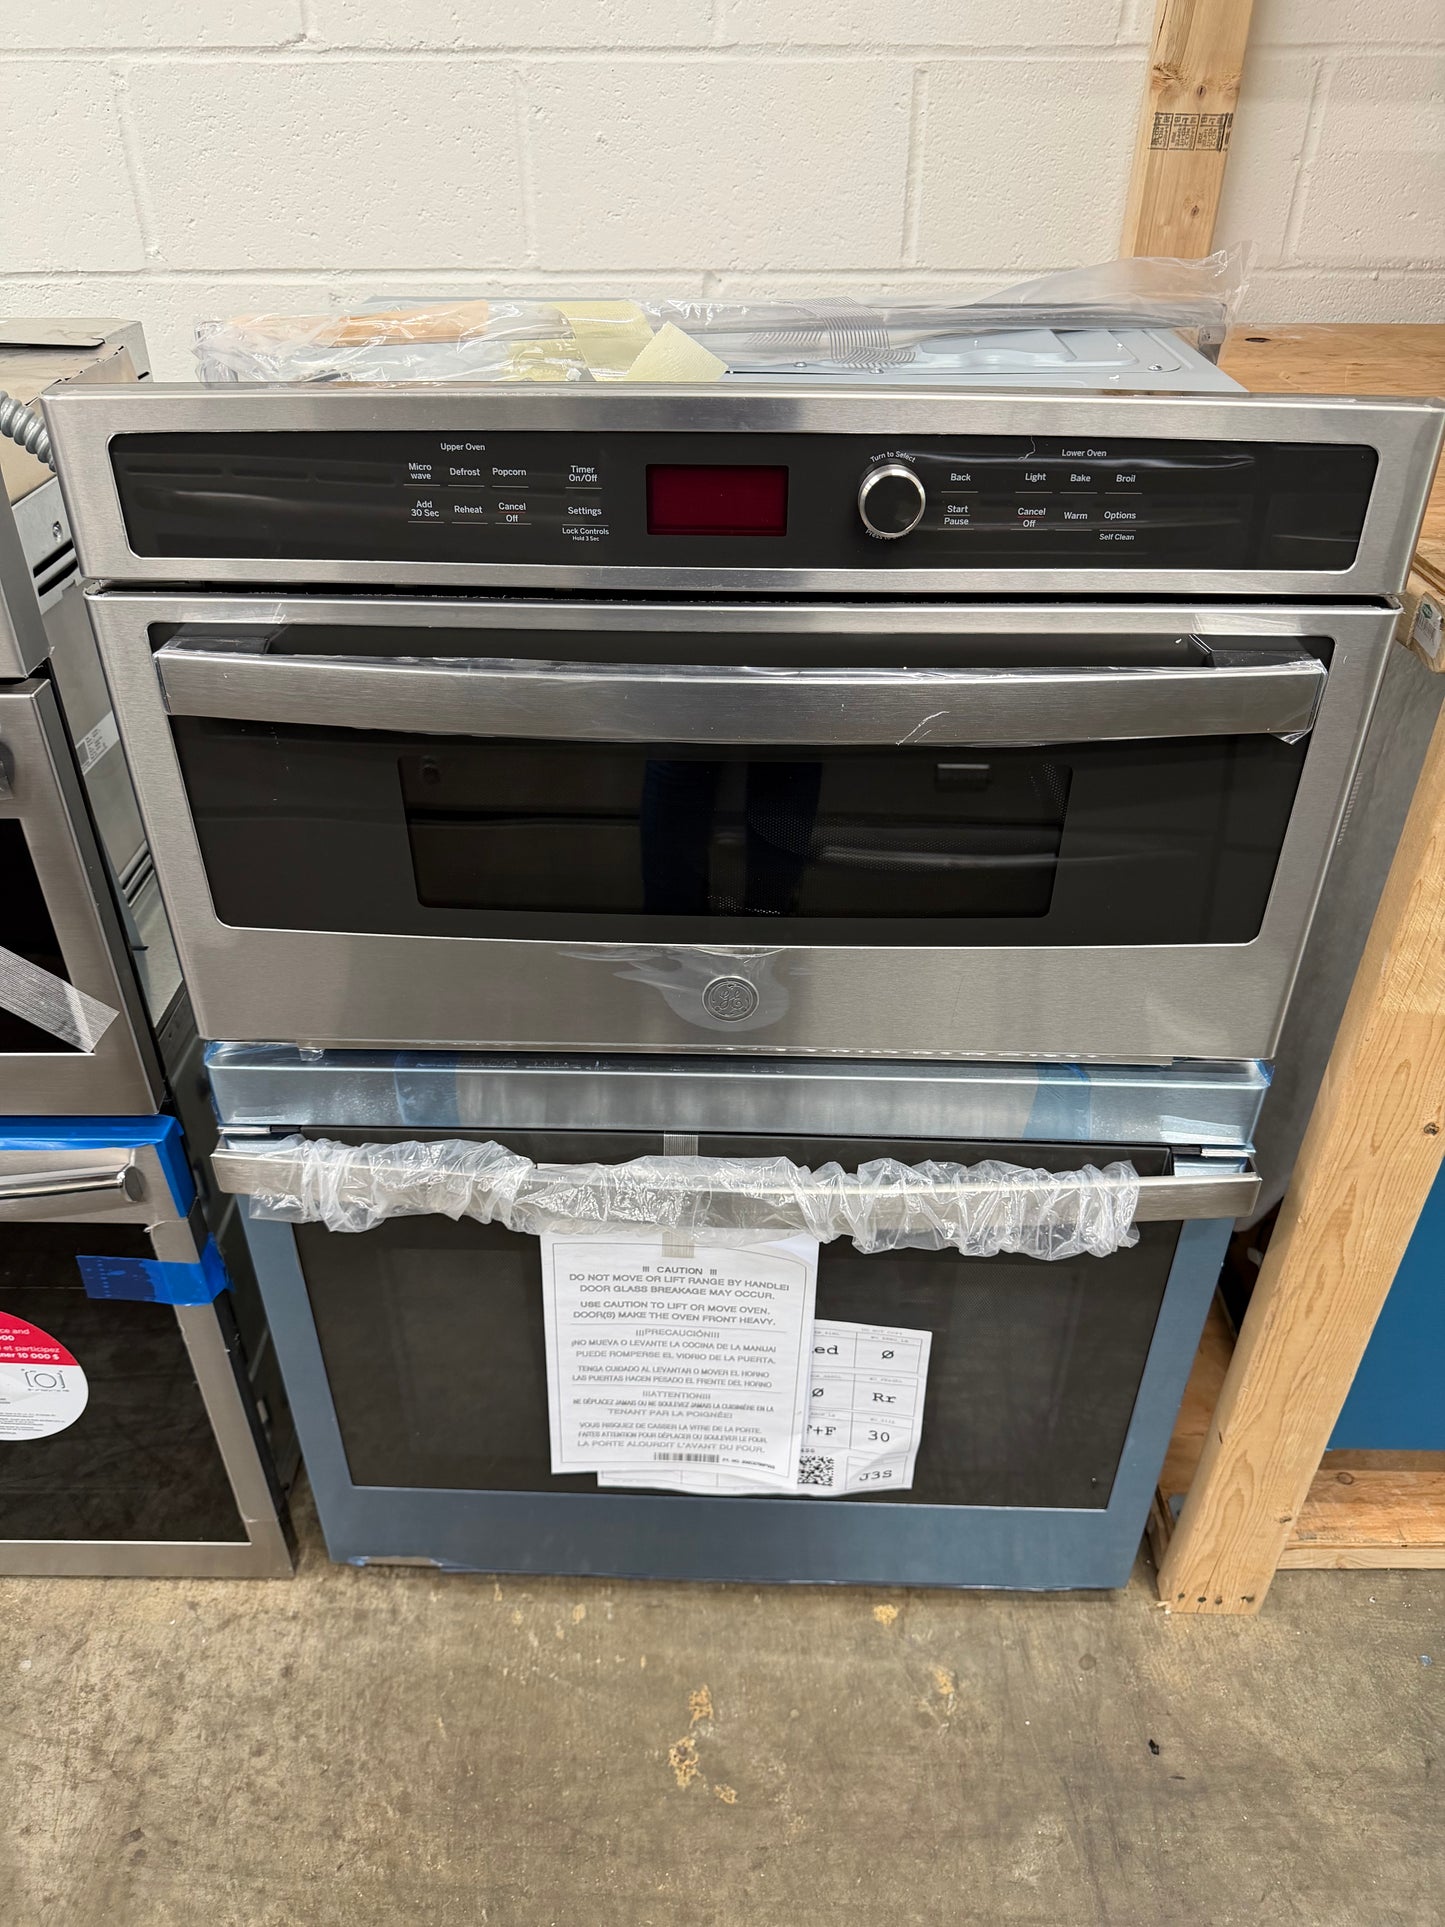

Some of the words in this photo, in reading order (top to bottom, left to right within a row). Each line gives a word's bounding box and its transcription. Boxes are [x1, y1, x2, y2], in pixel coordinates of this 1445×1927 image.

[440, 442, 464, 452] Upper
[465, 442, 486, 451] Oven
[869, 453, 886, 463] Turn
[895, 450, 916, 463] Select
[1061, 449, 1085, 457] Lower
[1086, 449, 1107, 457] Oven
[408, 462, 432, 471] Micro
[570, 465, 595, 474] Timer
[449, 467, 480, 476] Defrost
[492, 467, 527, 477] Popcorn
[568, 473, 598, 482] On/Off
[950, 473, 971, 482] Back
[1025, 472, 1047, 483] Light
[1070, 473, 1091, 482] Bake
[1116, 474, 1136, 483] Broil
[416, 500, 433, 508] Add
[498, 502, 527, 511] Cancel
[411, 508, 423, 517] 30
[424, 509, 440, 517] Sec
[454, 505, 483, 514] Reheat
[567, 506, 602, 516] Settings
[947, 505, 969, 513] Start
[1017, 507, 1046, 516] Cancel
[505, 514, 518, 522] Off
[1063, 511, 1088, 520] Warm
[1103, 510, 1137, 520] Options
[943, 517, 969, 525] Pause
[1022, 519, 1036, 528] Off
[562, 527, 579, 535] Lock
[580, 527, 610, 535] Controls
[1099, 533, 1114, 541] Self
[656, 1266, 703, 1275] CAUTION
[569, 1273, 585, 1281] DO
[612, 1274, 643, 1282] MOVE
[645, 1275, 661, 1283] OR
[688, 1276, 725, 1286] RANGE
[727, 1279, 742, 1287] BY
[613, 1285, 648, 1293] GLASS
[651, 1286, 706, 1296] BREAKAGE
[709, 1289, 732, 1297] MAY
[734, 1290, 775, 1300] OCCUR.
[667, 1302, 687, 1310] LIFT
[690, 1303, 705, 1311] OR
[707, 1305, 737, 1313] MOVE
[740, 1306, 770, 1315] OVEN.
[573, 1311, 616, 1320] DOOR(S)
[648, 1312, 669, 1320] THE
[671, 1313, 699, 1321] OVEN
[702, 1315, 737, 1323] FRONT
[740, 1316, 776, 1326] HEAVY.
[682, 1341, 714, 1349] COCINA
[812, 1345, 839, 1355] ed
[676, 1352, 707, 1360] VIDRIO
[737, 1355, 776, 1364] PUERTA.
[605, 1365, 640, 1373] CUIDADO
[652, 1366, 692, 1375] LEVANTAR
[701, 1368, 729, 1376] MOVER
[653, 1376, 684, 1384] PESADO
[727, 1379, 742, 1387] DEL
[744, 1380, 772, 1388] HORNO
[872, 1392, 897, 1404] Rr
[608, 1408, 647, 1416] TENANT
[647, 1422, 677, 1430] CASSER
[678, 1423, 688, 1431] LA
[868, 1430, 890, 1443] 30
[627, 1441, 676, 1449] ALOURDIT
[735, 1446, 765, 1454] FOUR.
[859, 1469, 893, 1482] J3S
